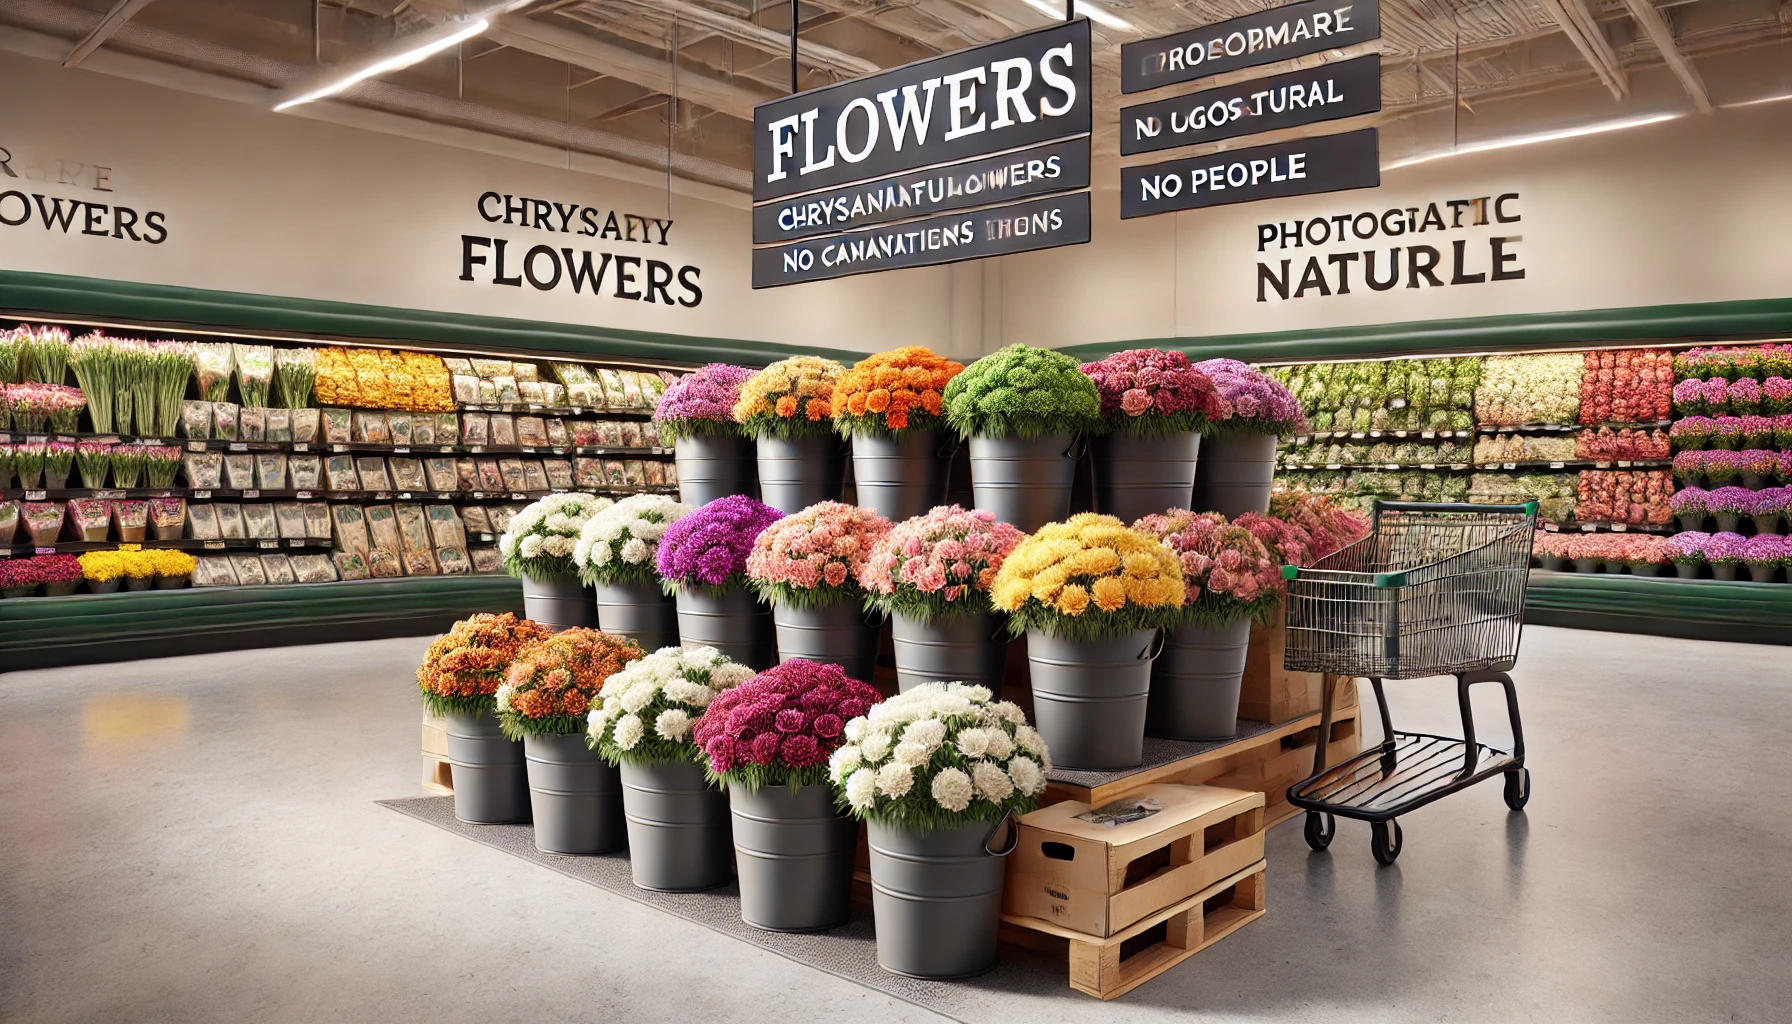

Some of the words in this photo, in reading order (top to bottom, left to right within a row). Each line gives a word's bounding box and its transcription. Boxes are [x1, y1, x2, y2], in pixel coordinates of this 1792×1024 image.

[768, 42, 1077, 184] FLOWERS
[1141, 174, 1182, 201] NO
[1191, 153, 1307, 194] PEOPLE
[459, 235, 703, 308] FLOWERS
[783, 249, 814, 273] NO
[1256, 235, 1526, 302] NATURLE
